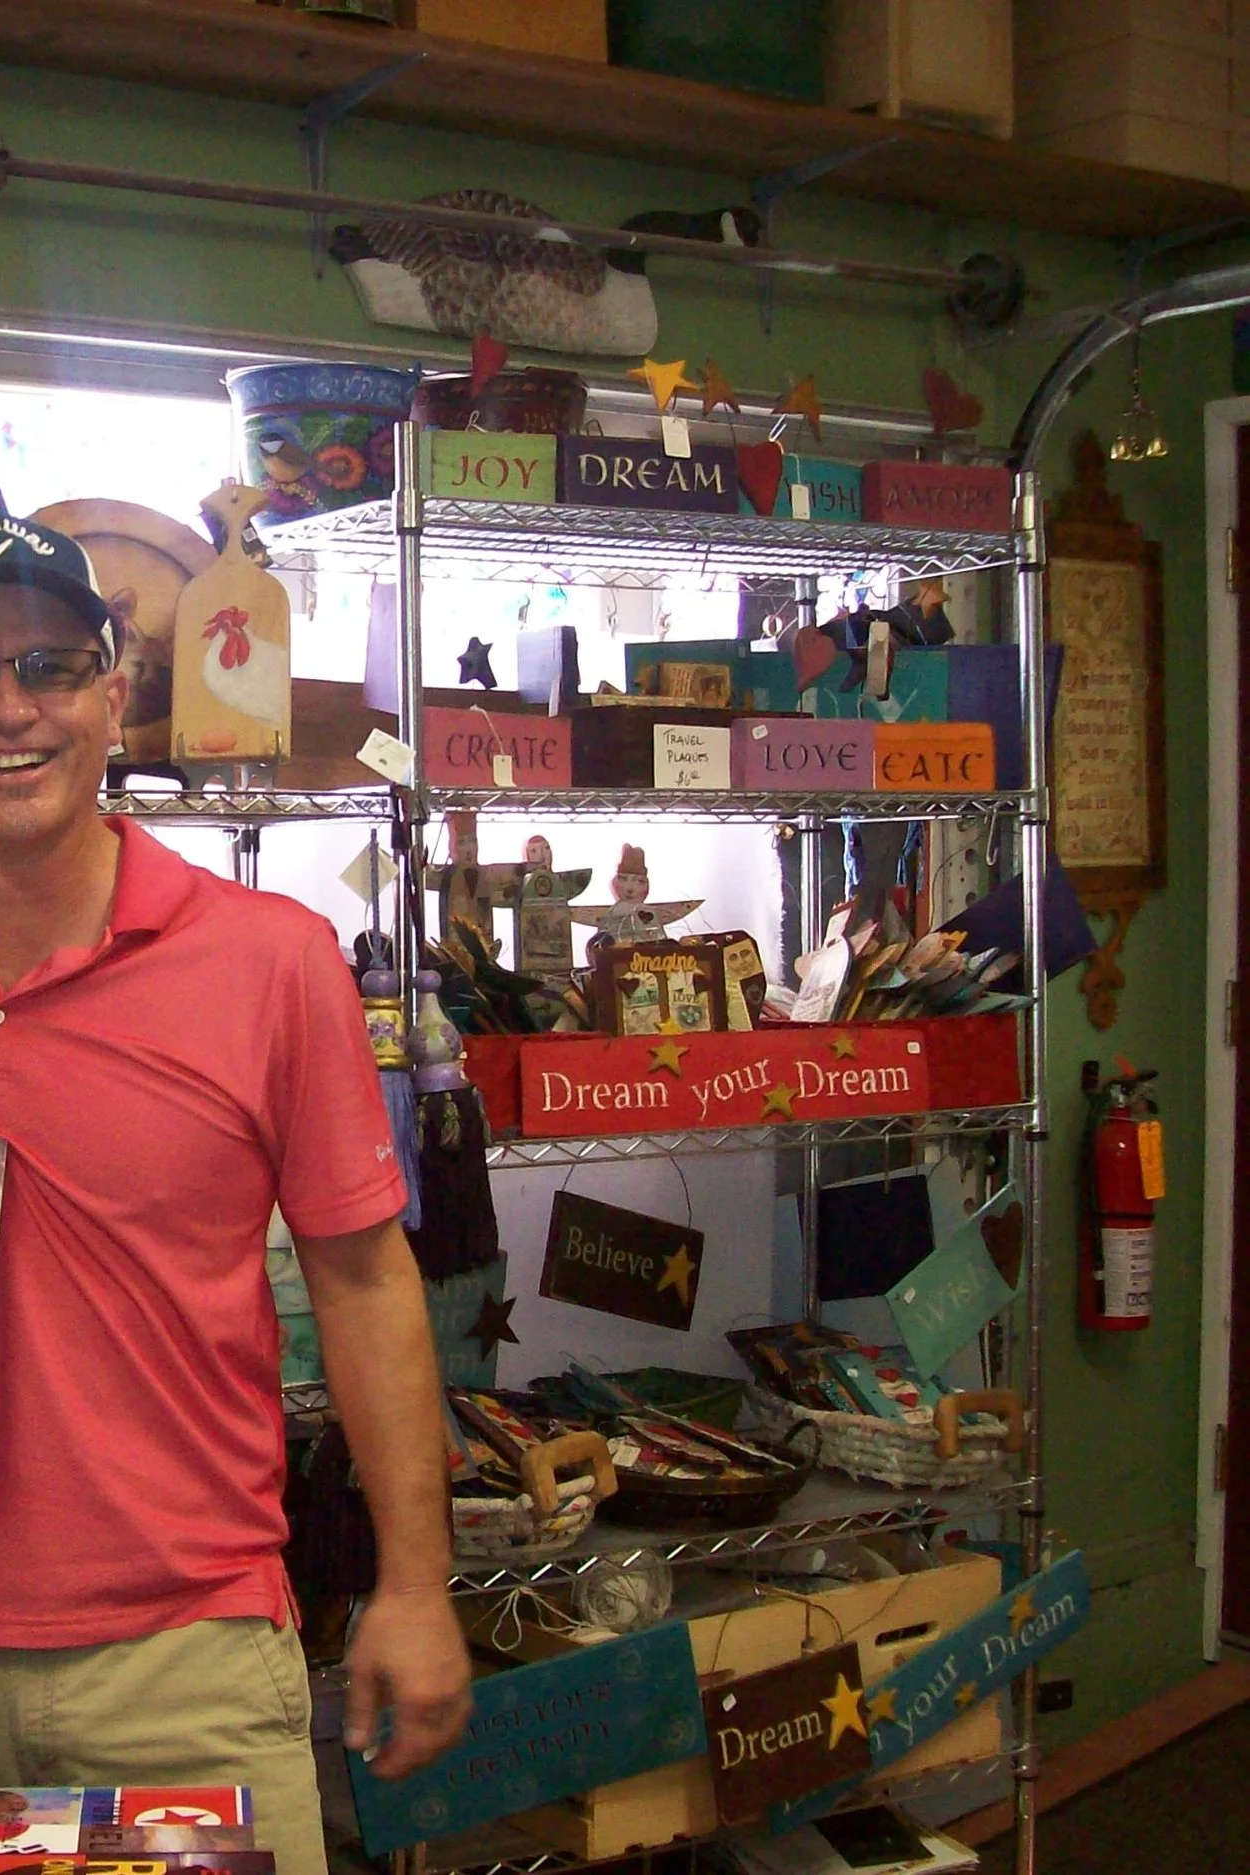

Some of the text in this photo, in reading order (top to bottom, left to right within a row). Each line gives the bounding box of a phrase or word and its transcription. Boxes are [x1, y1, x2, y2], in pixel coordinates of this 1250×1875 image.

[451, 455, 539, 490] JOY
[578, 453, 726, 495] DREAM
[662, 728, 705, 747] TRAVEL
[666, 749, 710, 765] PLAQUES
[763, 742, 858, 772] LOVE
[629, 952, 698, 974] Imagine
[541, 1058, 911, 1121] Dream your Dream
[563, 1226, 654, 1280] Believe
[896, 1653, 958, 1746] your
[717, 1709, 824, 1771] Dream
